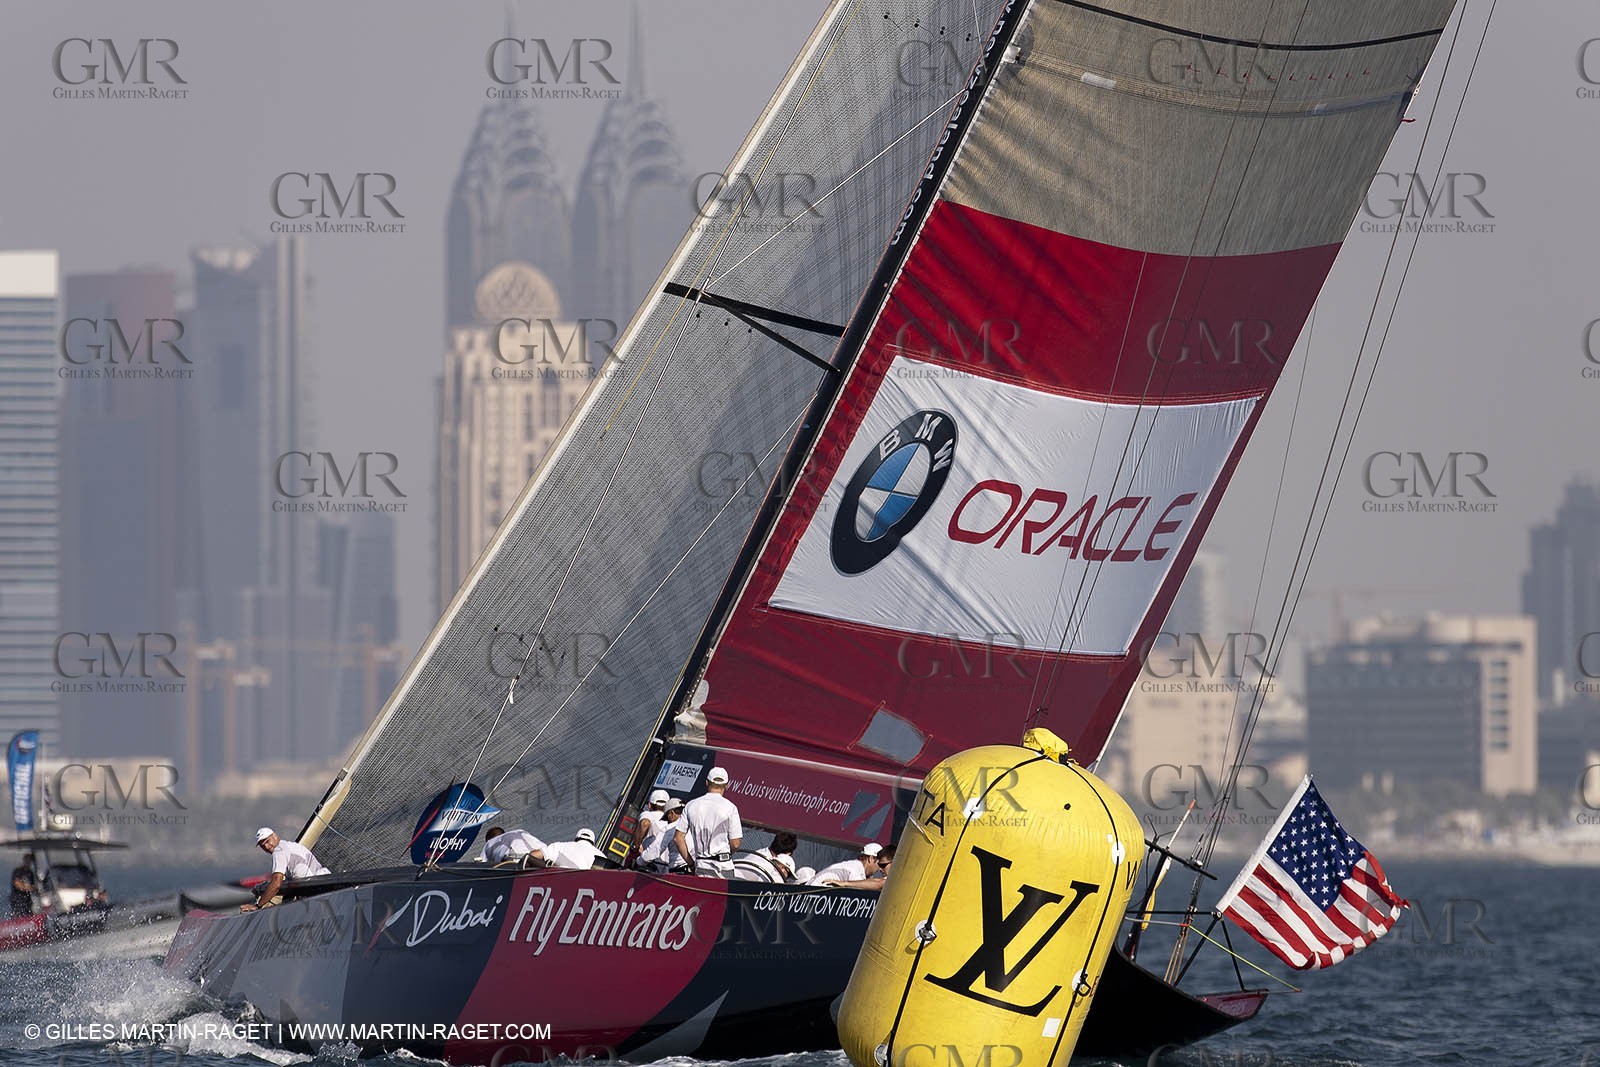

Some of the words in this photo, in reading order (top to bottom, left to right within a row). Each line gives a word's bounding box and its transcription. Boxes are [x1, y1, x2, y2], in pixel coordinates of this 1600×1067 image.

[879, 413, 953, 473] BMW
[948, 479, 1199, 562] ORACLE
[671, 765, 700, 778] MAERSK
[406, 888, 503, 947] Dubai
[509, 887, 567, 956] Fly
[559, 888, 700, 951] Emirates
[754, 891, 788, 911] LOUIS
[788, 894, 838, 915] VUITTON
[835, 896, 877, 918] TROPHY
